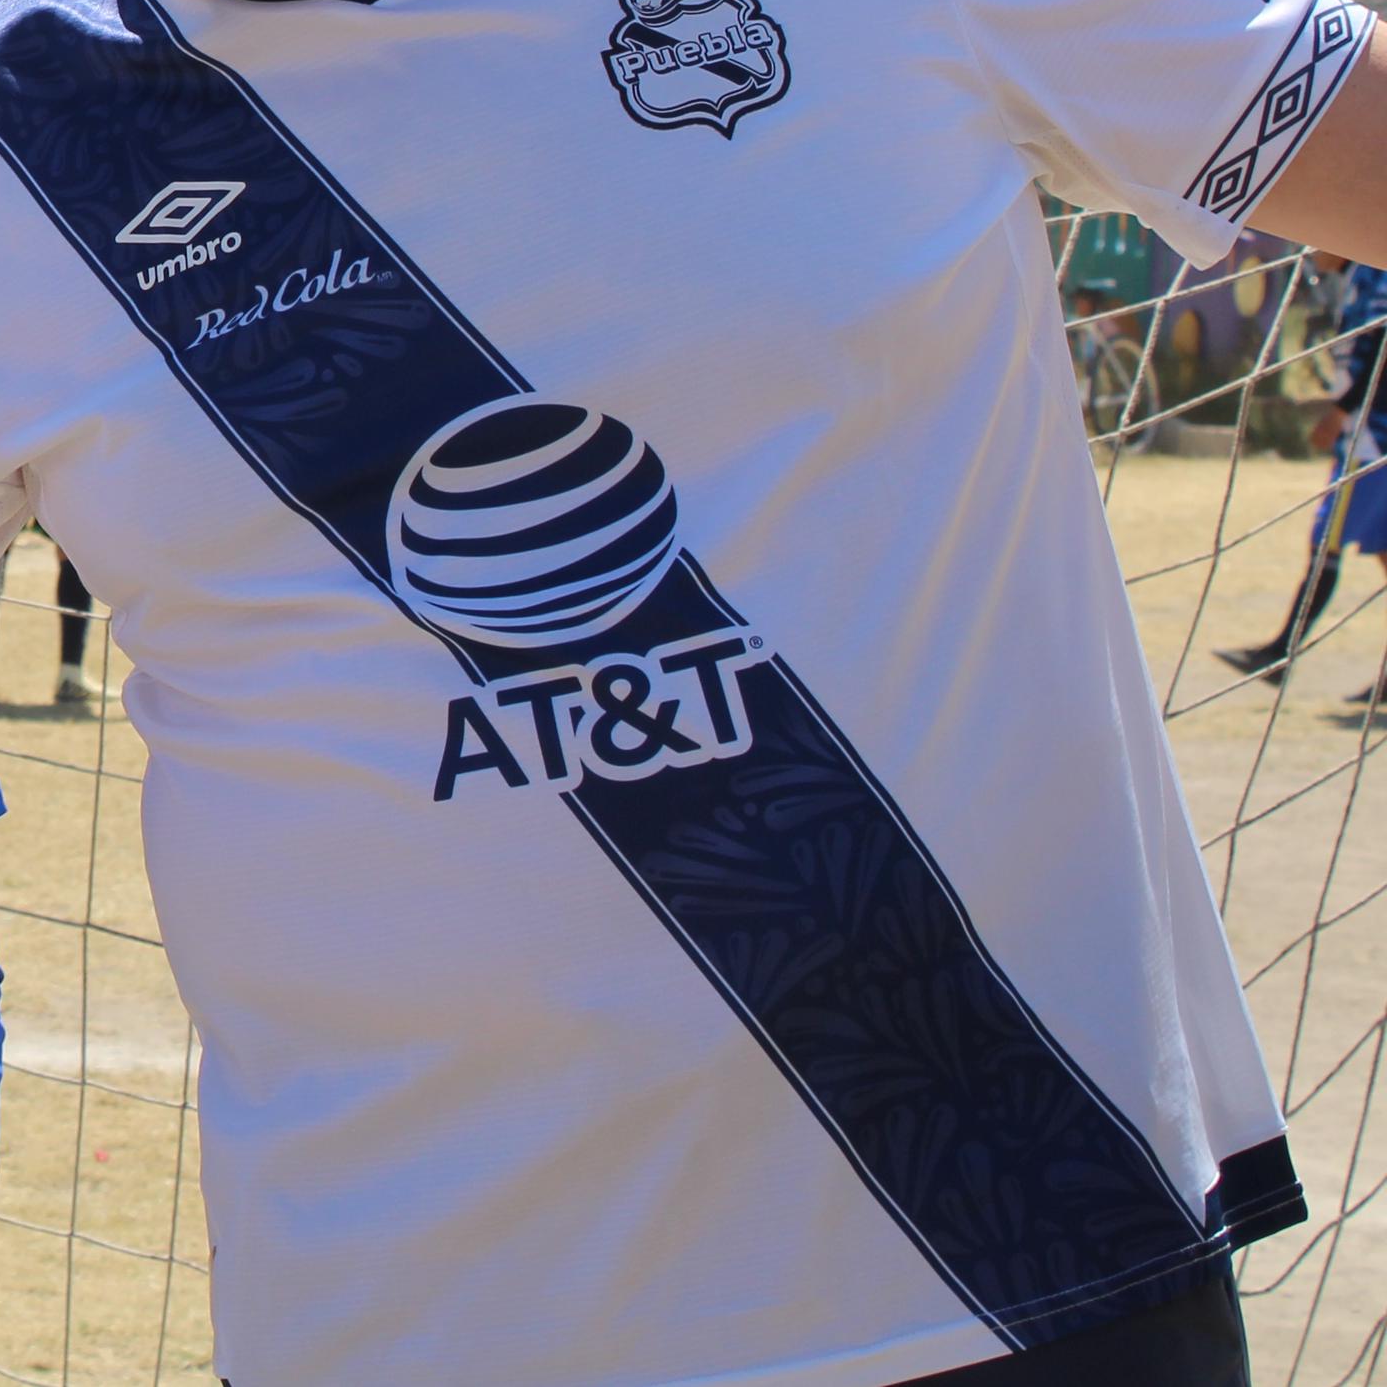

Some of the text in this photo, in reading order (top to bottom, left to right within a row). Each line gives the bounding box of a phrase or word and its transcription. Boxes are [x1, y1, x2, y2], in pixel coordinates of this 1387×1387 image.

[616, 22, 773, 84] Puebla
[136, 231, 242, 291] umbro
[186, 285, 269, 351] Red
[273, 248, 376, 313] Cola
[433, 637, 748, 802] AT&T
